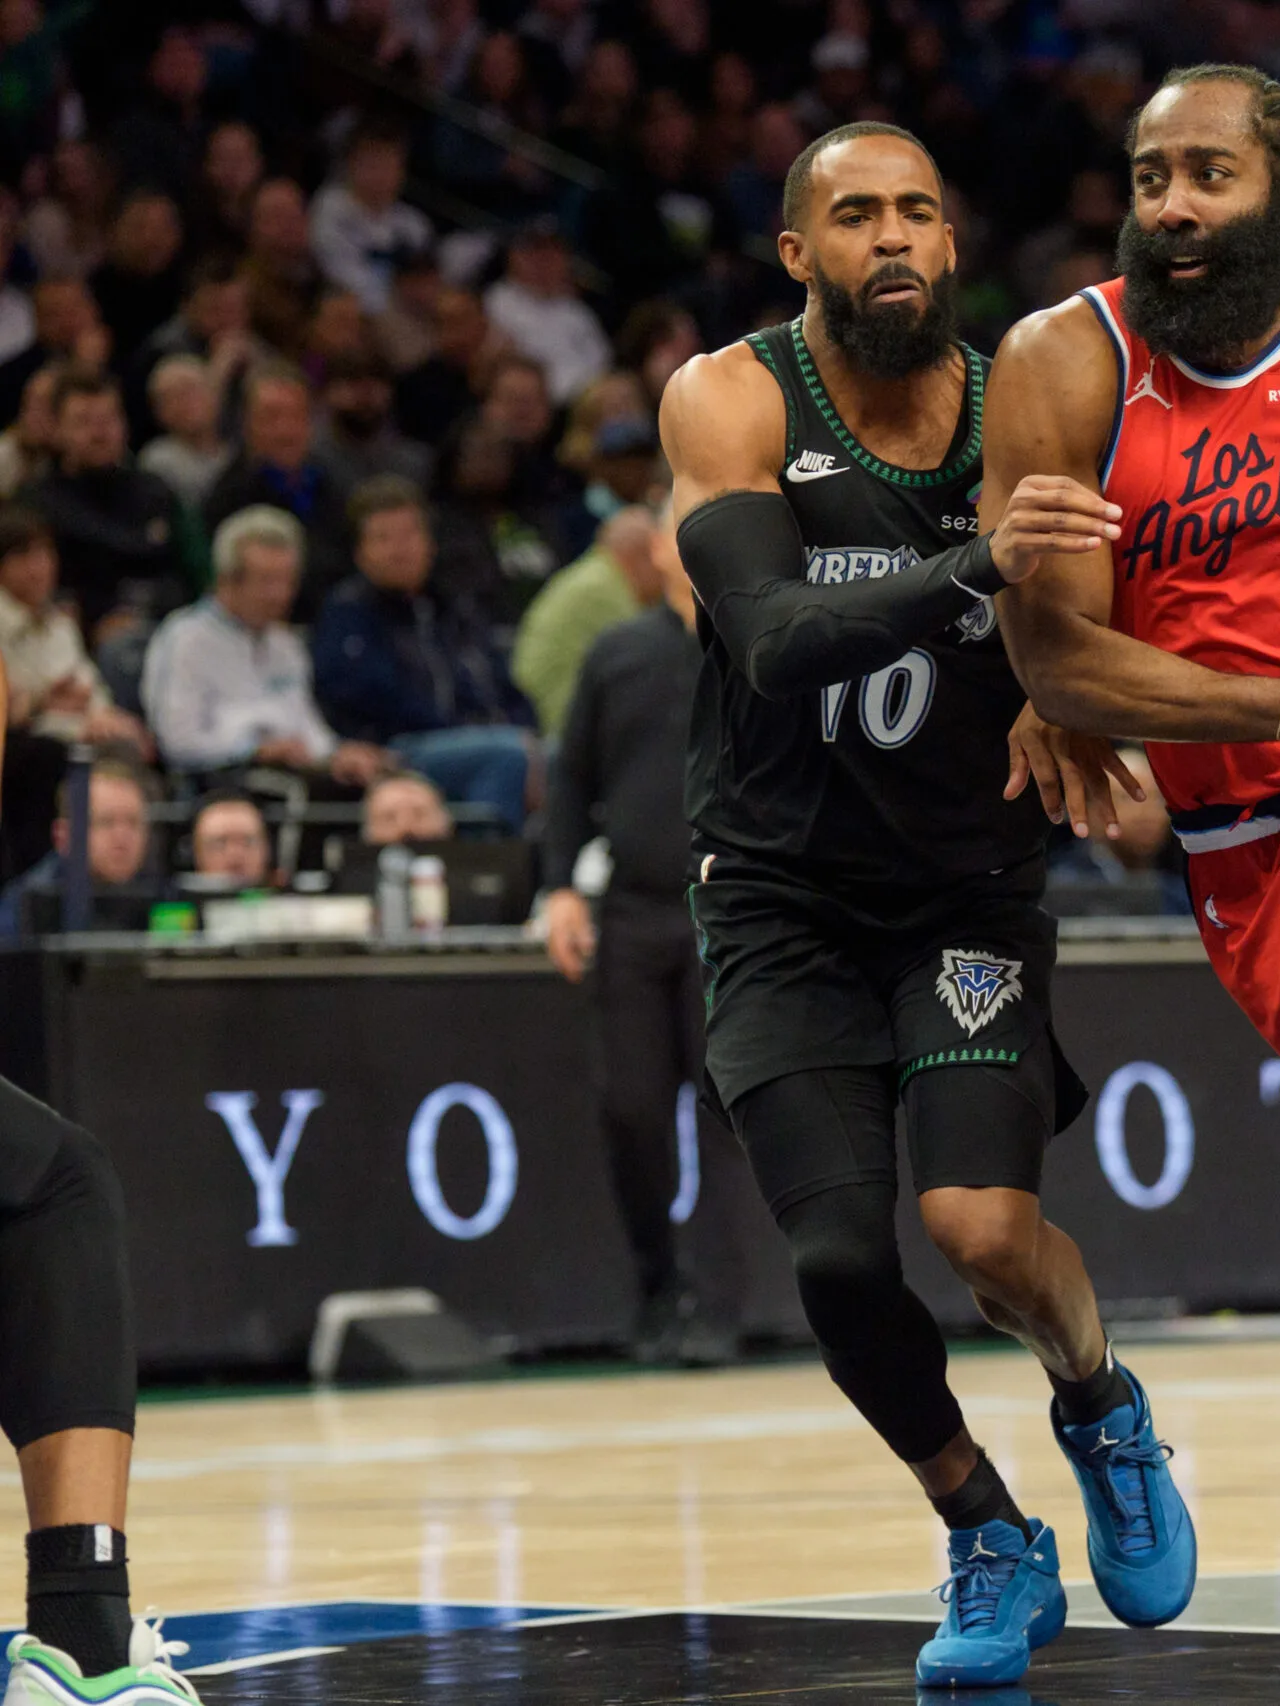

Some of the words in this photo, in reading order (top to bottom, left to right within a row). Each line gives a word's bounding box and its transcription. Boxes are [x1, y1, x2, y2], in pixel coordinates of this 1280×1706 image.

[797, 449, 836, 471] NIKE
[1176, 427, 1274, 507] Los
[940, 514, 978, 532] sez
